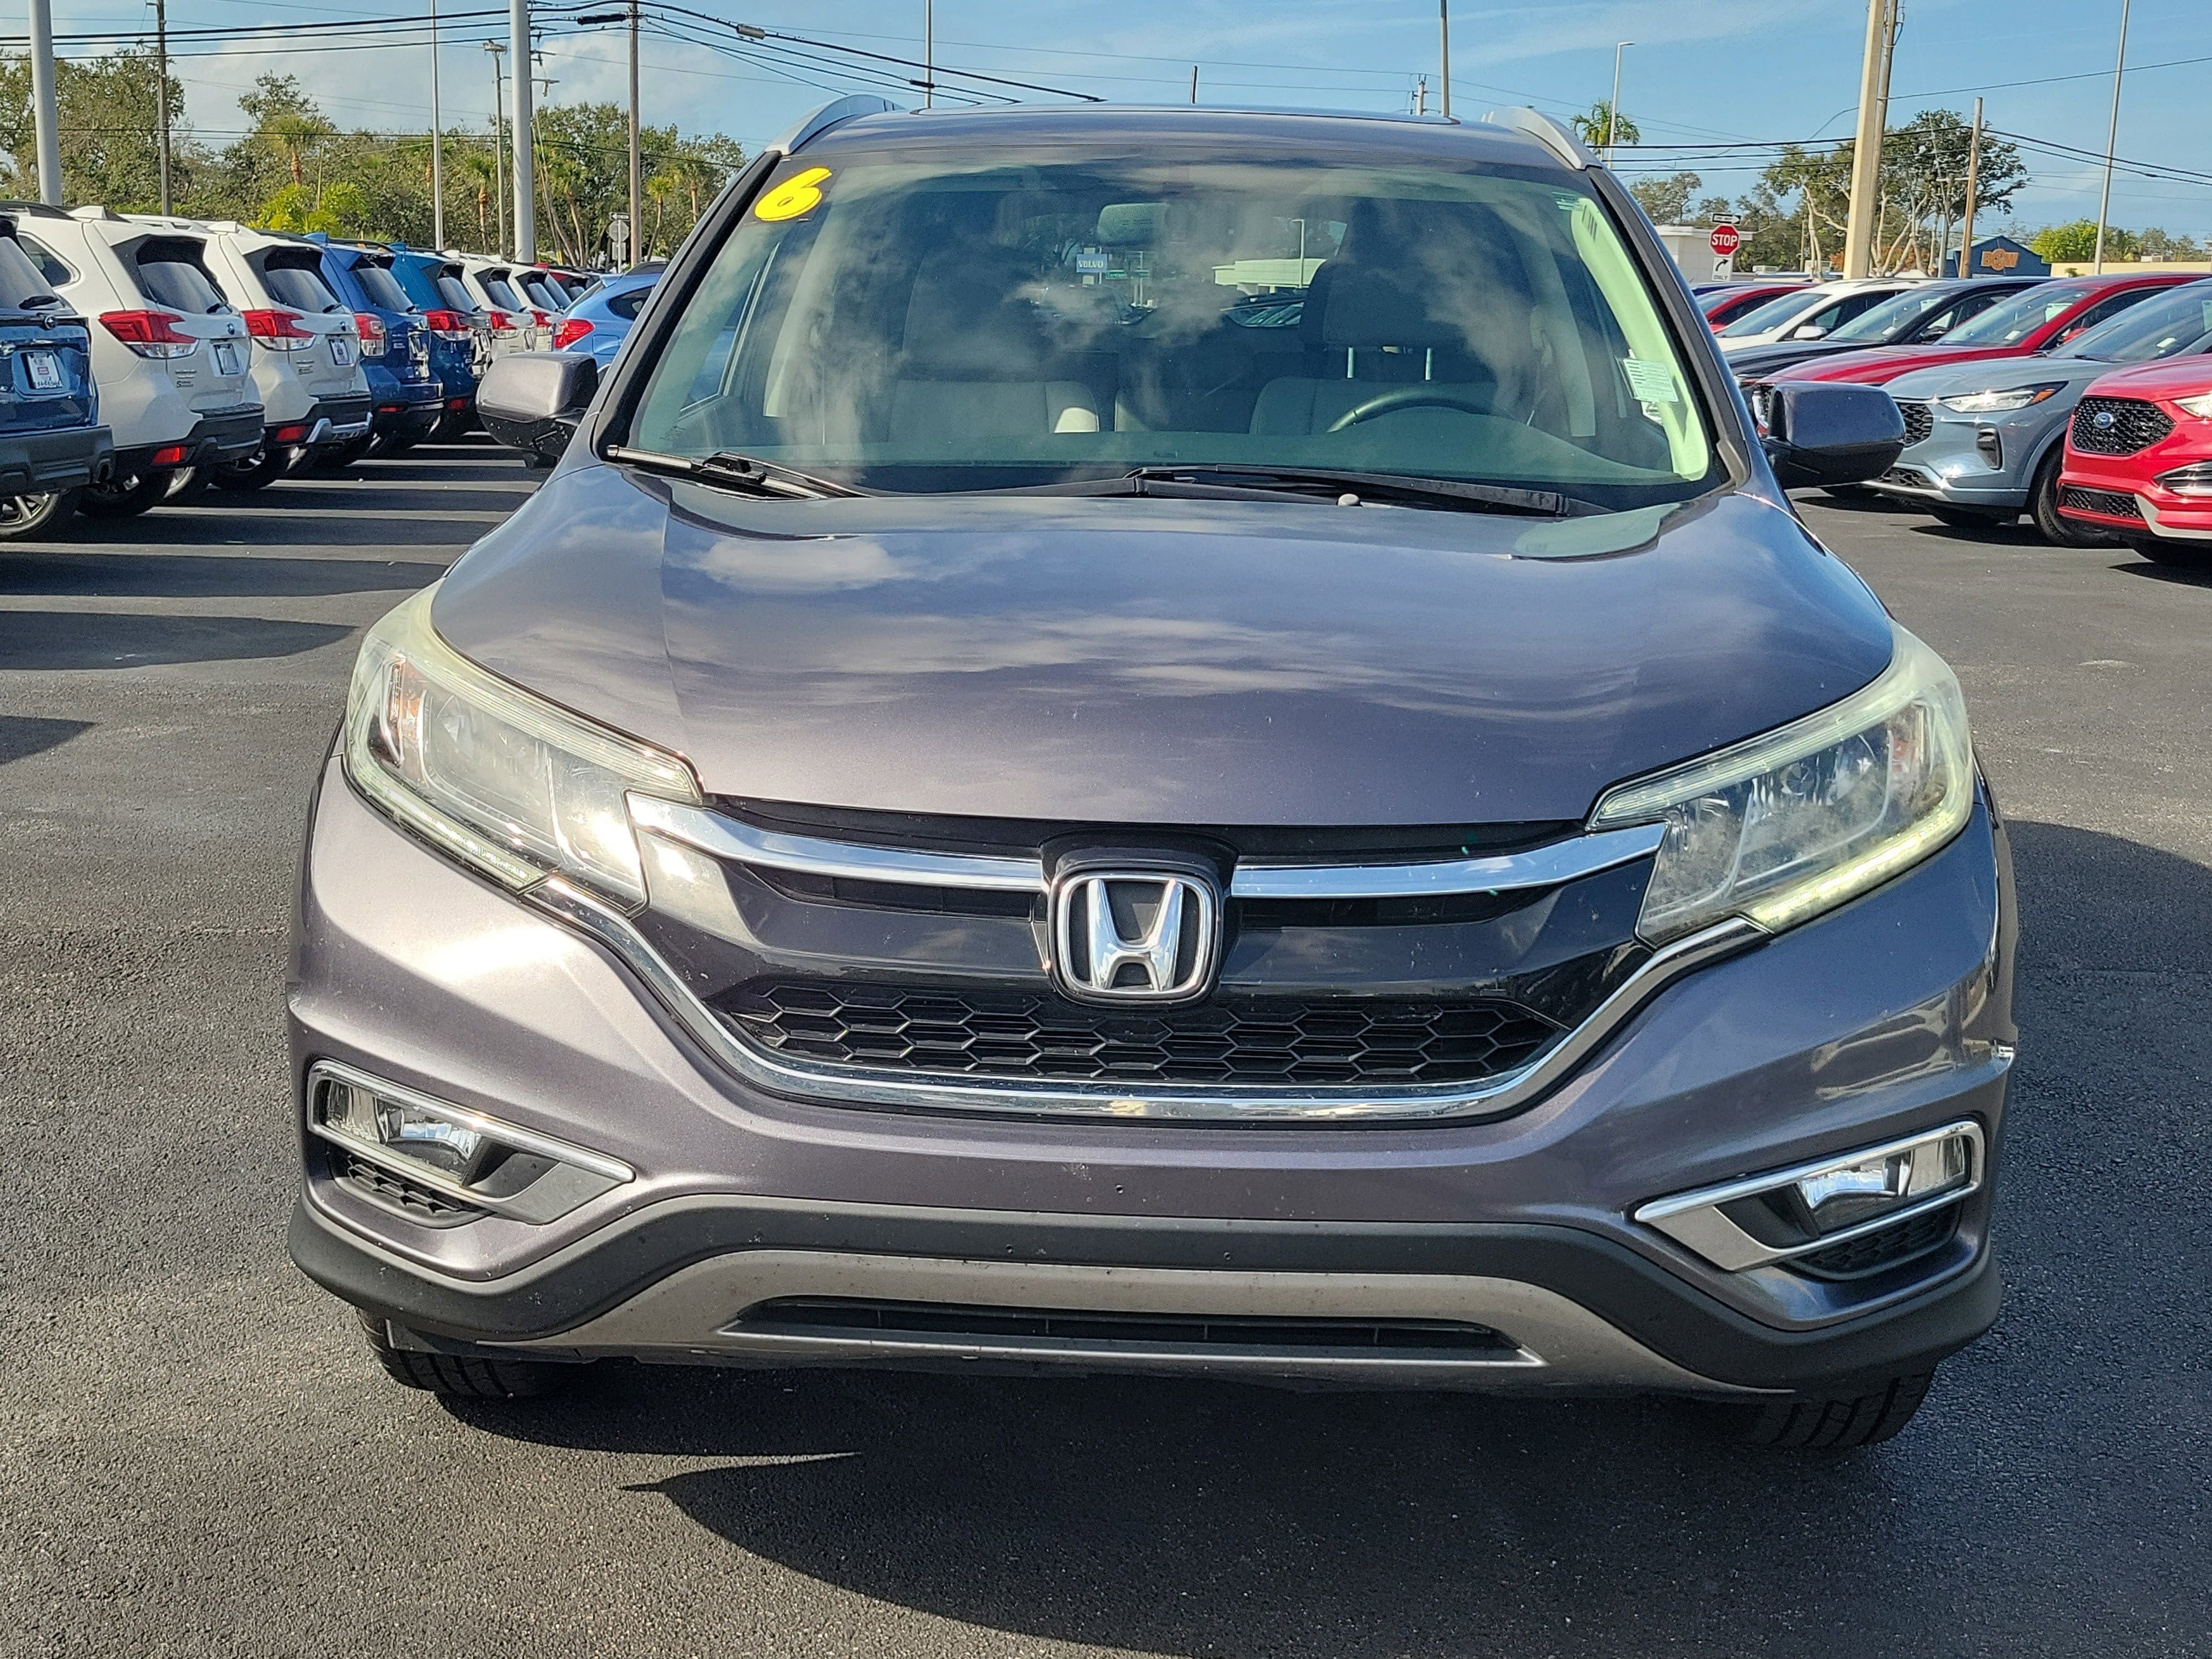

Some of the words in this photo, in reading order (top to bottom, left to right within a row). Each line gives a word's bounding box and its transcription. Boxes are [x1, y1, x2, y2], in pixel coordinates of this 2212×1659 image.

[754, 166, 832, 222] 6
[1712, 234, 1737, 246] STOP
[1079, 260, 1103, 268] VOLVO
